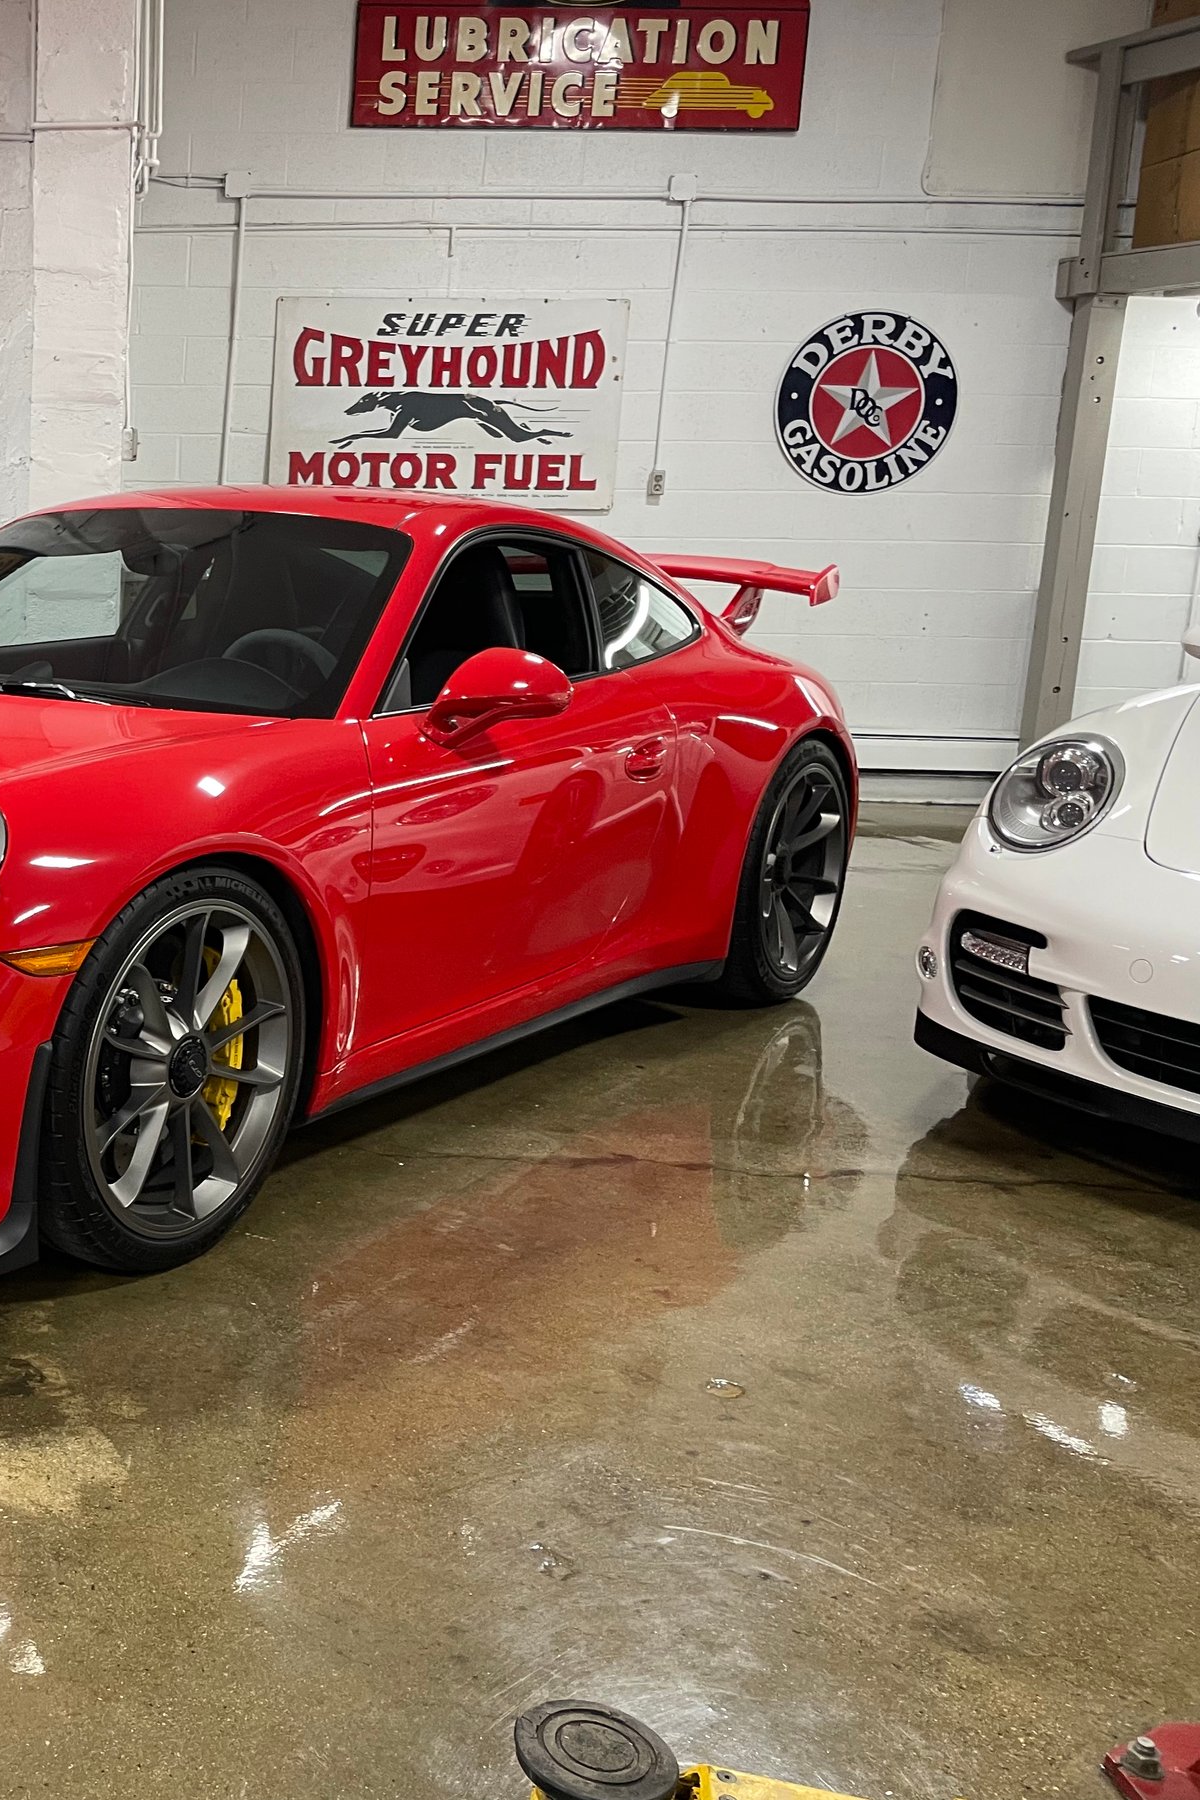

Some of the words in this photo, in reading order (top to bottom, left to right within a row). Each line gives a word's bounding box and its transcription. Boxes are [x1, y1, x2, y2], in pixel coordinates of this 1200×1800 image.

[380, 15, 781, 65] LUBRICATION
[377, 71, 621, 117] SERVICE
[376, 312, 528, 338] SUPER
[792, 314, 954, 379] DERBY
[293, 326, 606, 389] GREYHOUND
[287, 451, 458, 490] MOTOR
[471, 453, 597, 491] FUEL
[783, 419, 947, 491] GASOLINE
